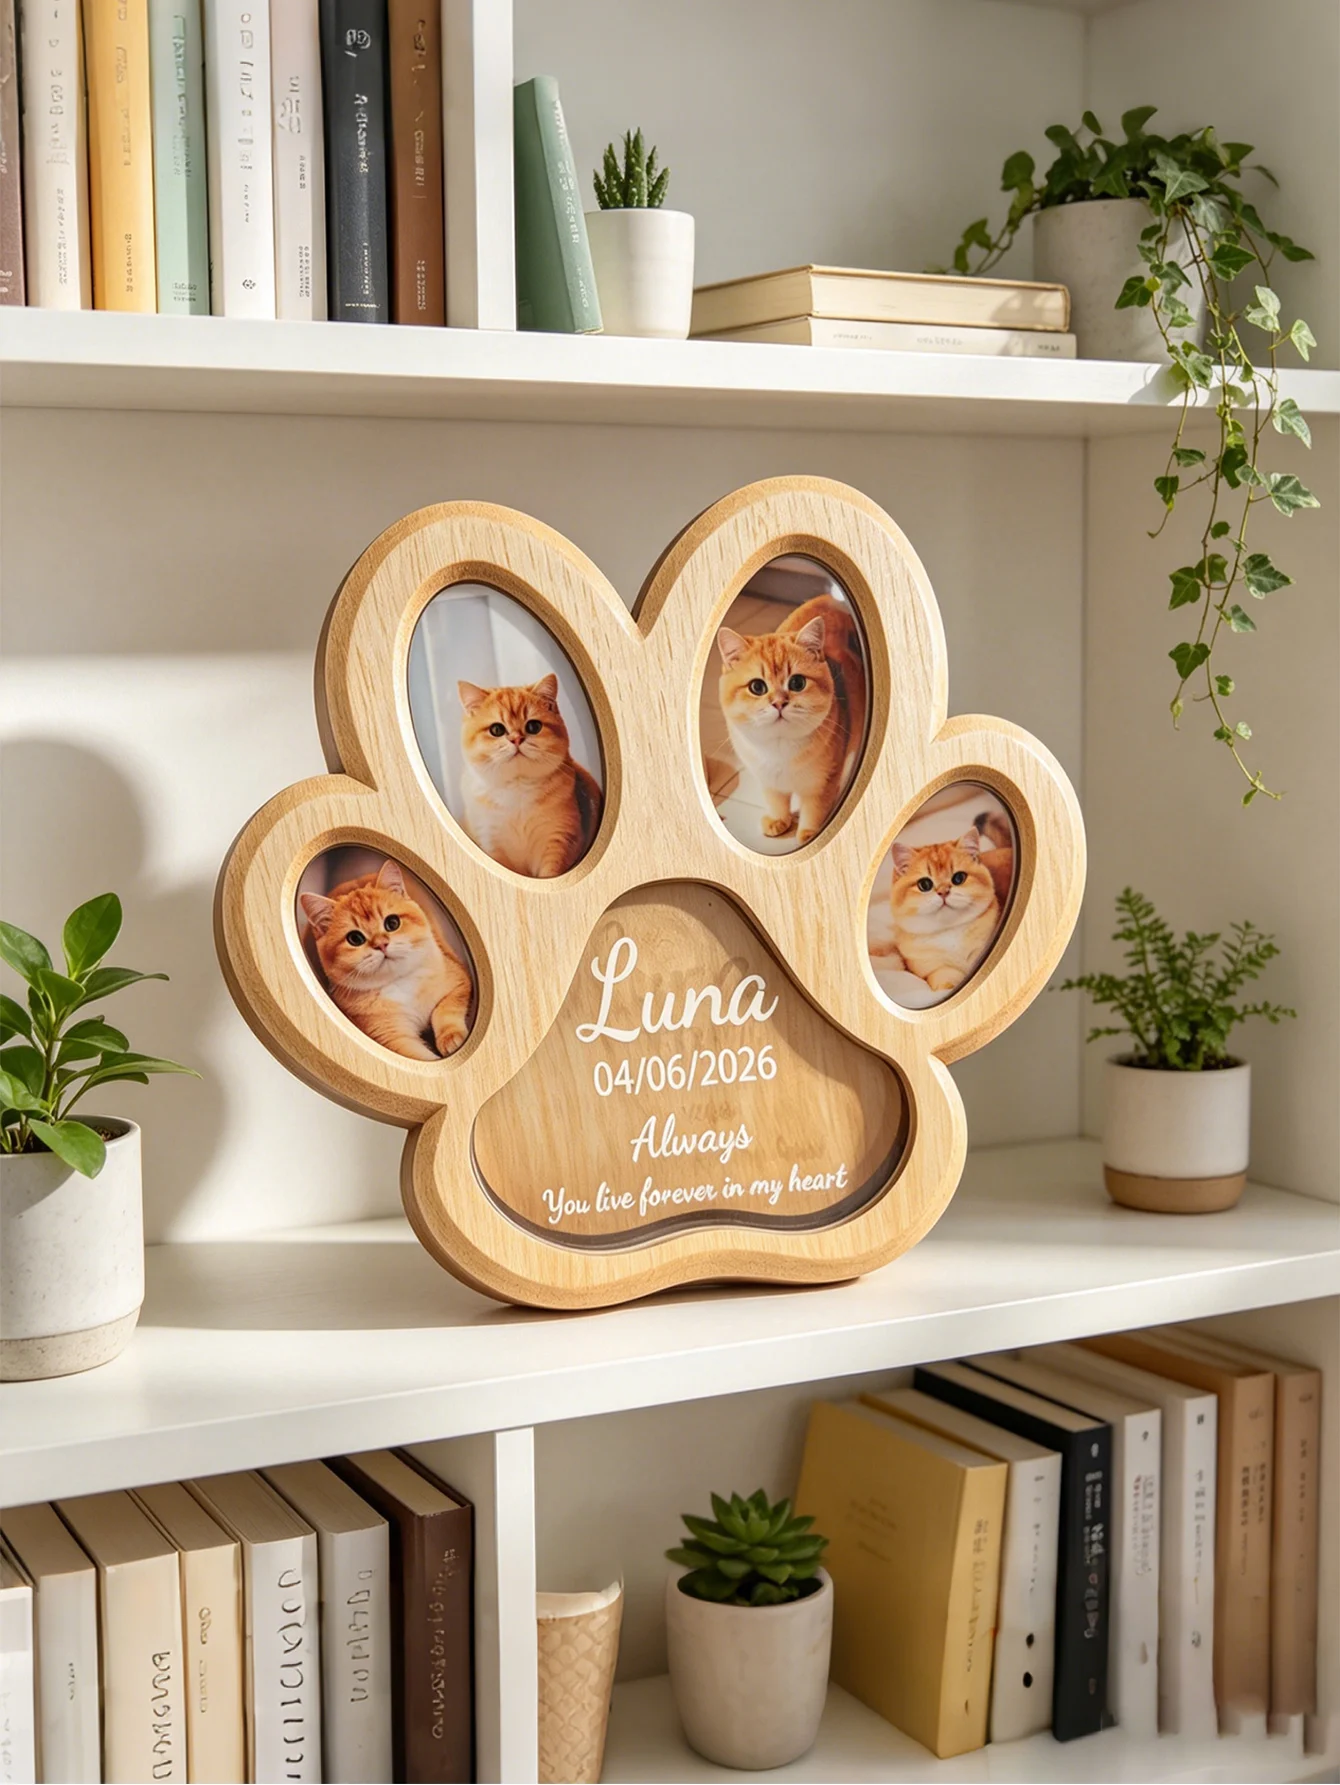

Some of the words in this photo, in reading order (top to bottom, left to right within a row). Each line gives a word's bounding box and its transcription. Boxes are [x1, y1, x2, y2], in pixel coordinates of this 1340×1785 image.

[576, 937, 779, 1043] Luna
[593, 1045, 778, 1097] 04/06/2026
[630, 1113, 754, 1164] Always
[542, 1186, 590, 1224] You
[595, 1181, 635, 1213] live
[639, 1176, 718, 1216] forever
[721, 1176, 744, 1198] in
[749, 1178, 784, 1205] my
[788, 1163, 849, 1193] heart
